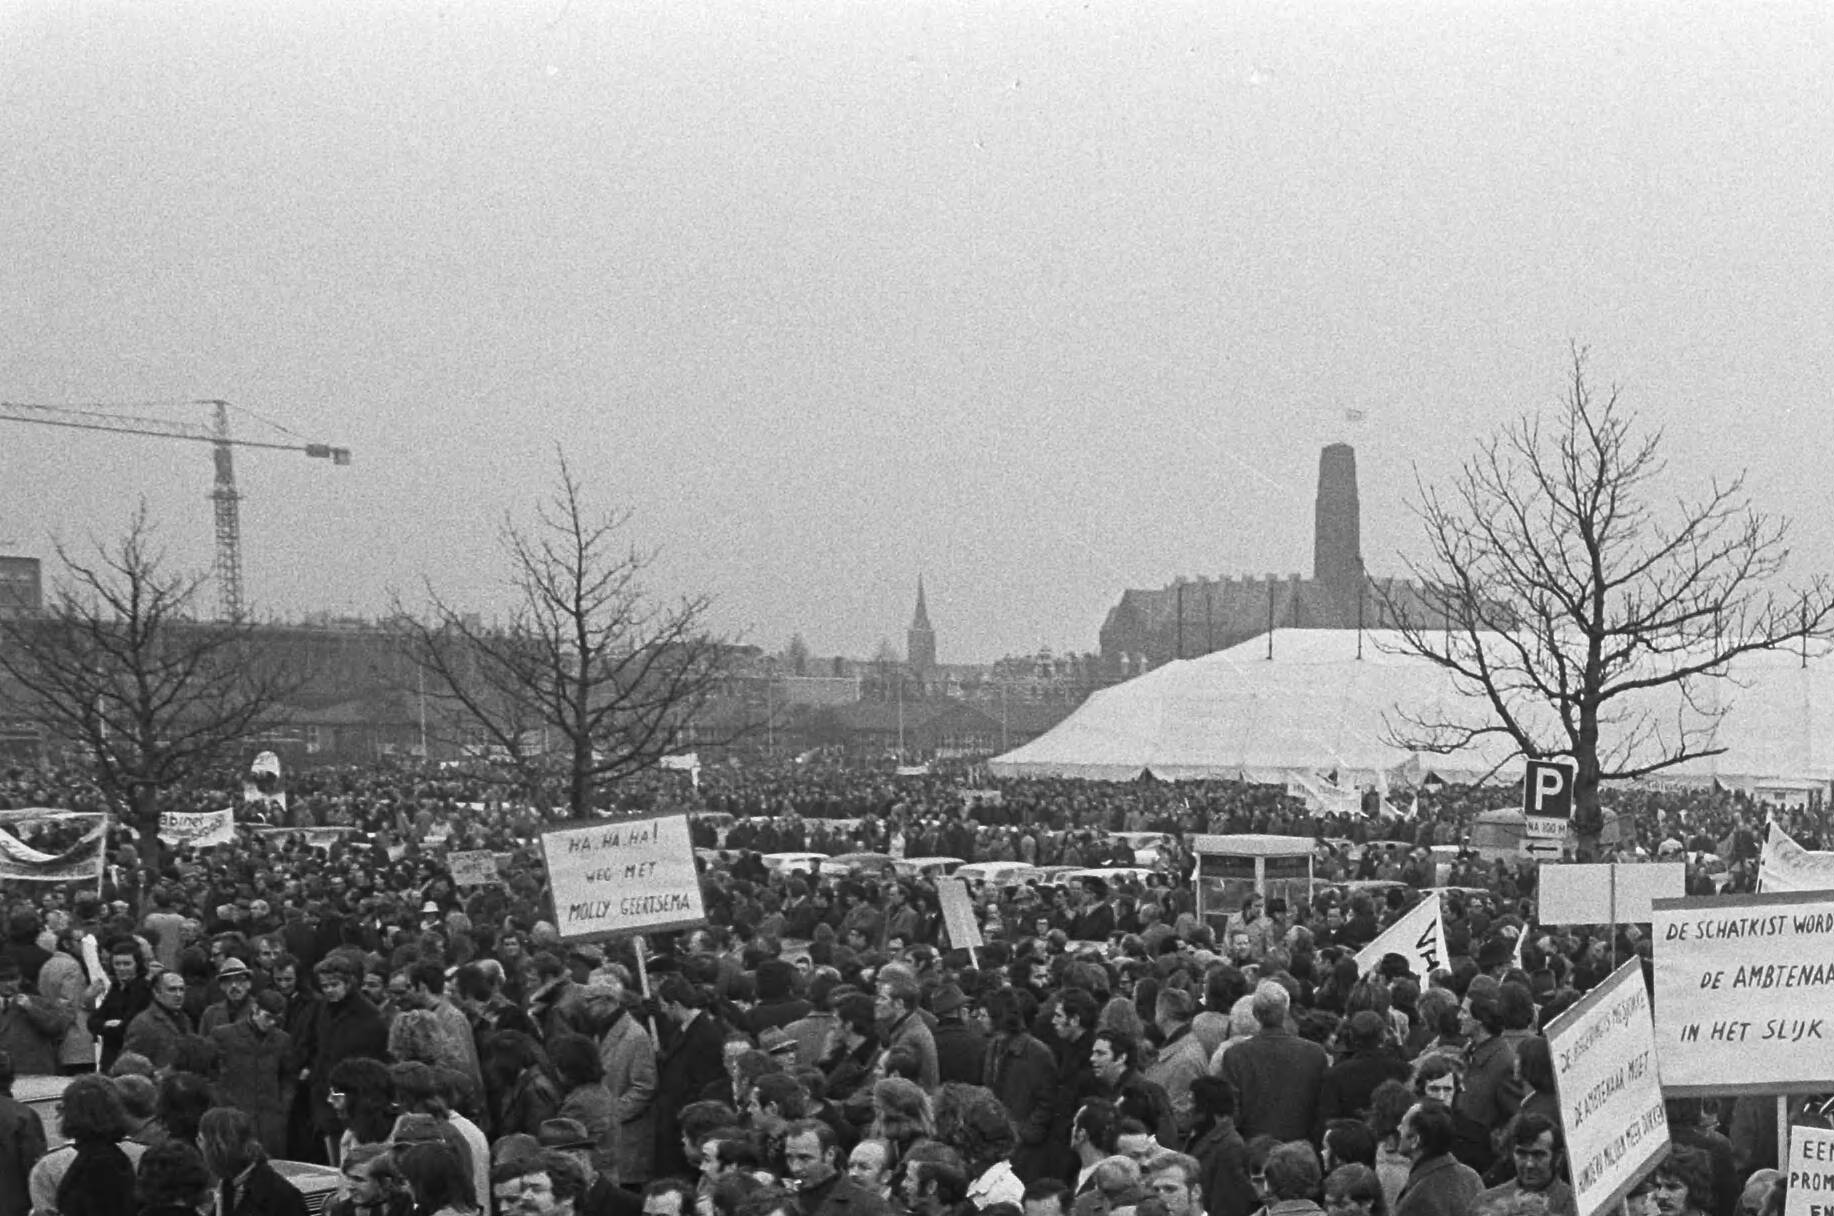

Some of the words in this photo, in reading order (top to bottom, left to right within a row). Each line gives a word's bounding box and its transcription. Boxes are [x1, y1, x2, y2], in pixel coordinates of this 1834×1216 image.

[1535, 767, 1563, 810] P
[624, 861, 656, 879] MET
[568, 900, 611, 922] MOLLY
[1665, 922, 1689, 940] DE
[1696, 915, 1788, 940] SCHATKIST
[1700, 971, 1725, 989] DE
[1681, 1024, 1700, 1043] IN
[1711, 1020, 1751, 1042] HET
